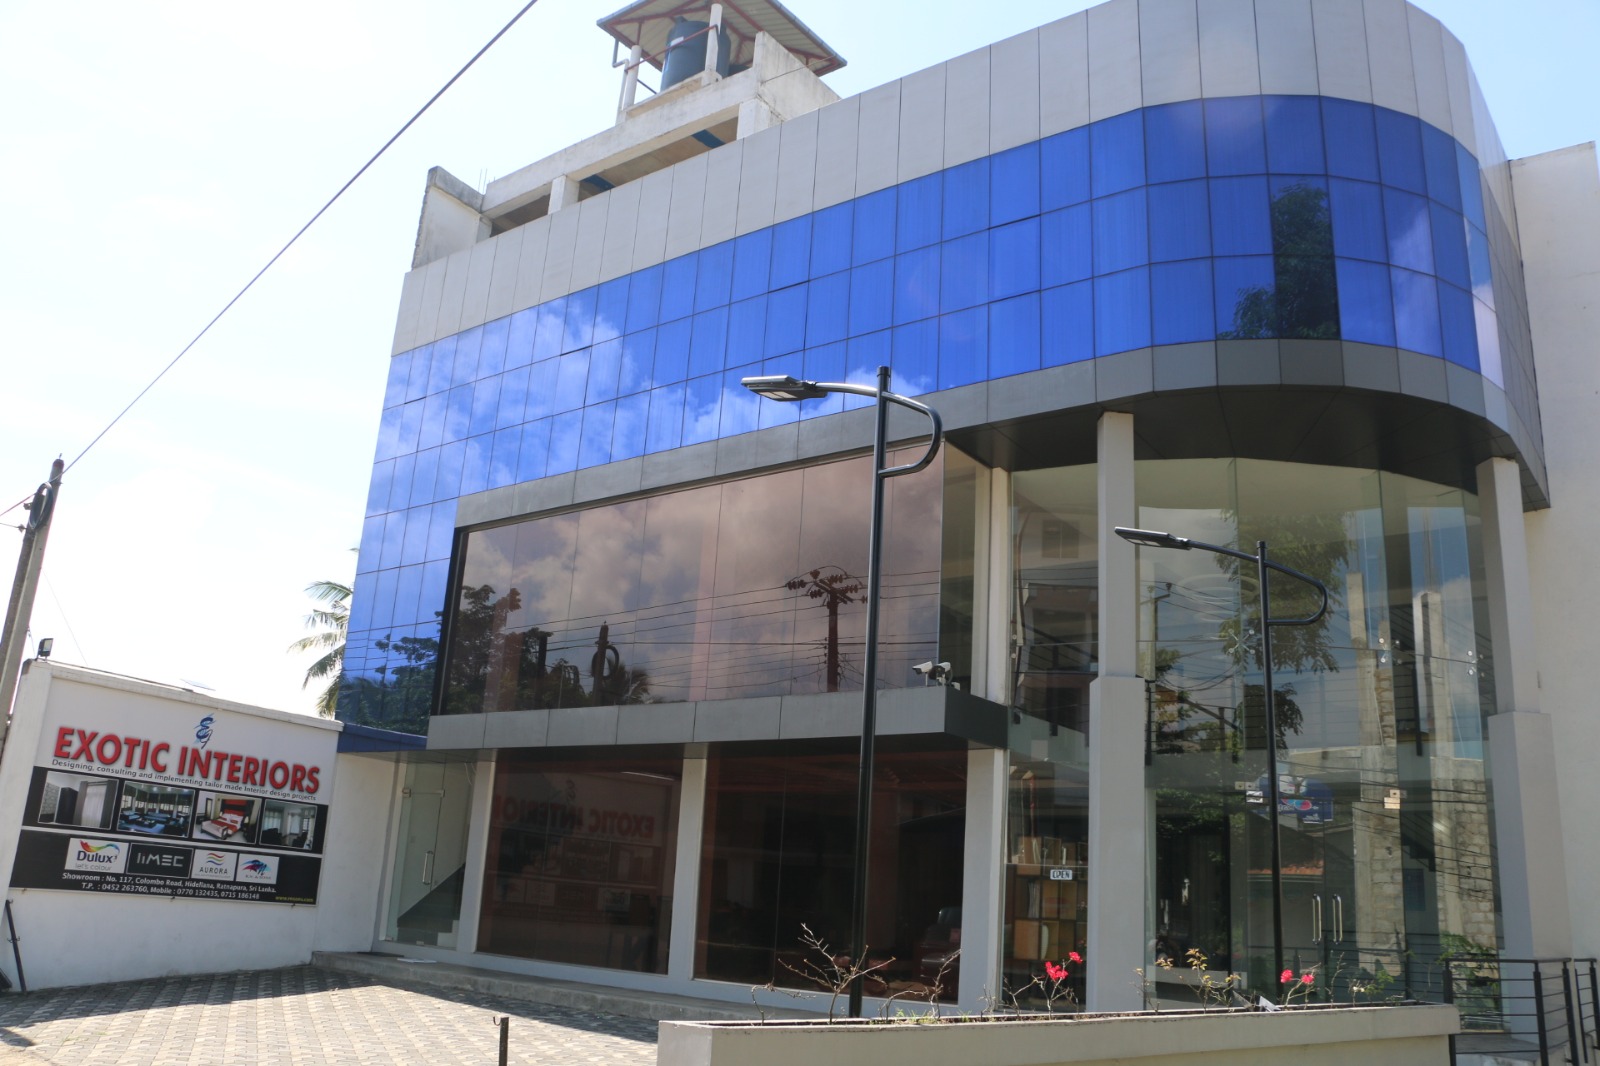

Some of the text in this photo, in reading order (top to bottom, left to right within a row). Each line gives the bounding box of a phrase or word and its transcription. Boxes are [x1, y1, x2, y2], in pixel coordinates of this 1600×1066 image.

[54, 726, 320, 794] EXOTIC INTERIORS
[52, 760, 95, 771] Designing,
[96, 766, 137, 777] consulting
[154, 773, 203, 786] implementing
[204, 780, 222, 789] tailor
[224, 784, 243, 792] made
[269, 790, 291, 799] design
[291, 793, 317, 802] projects
[76, 850, 112, 863] Dulux
[199, 866, 228, 875] AURORA
[1052, 870, 1070, 879] OPEN
[62, 872, 100, 881] Showroom
[135, 877, 164, 886] Colombo
[165, 879, 183, 887] Road,
[216, 883, 248, 891] Ratnapura,
[81, 882, 94, 890] T.P.
[101, 883, 120, 891] 0452
[150, 886, 172, 894] Mobile
